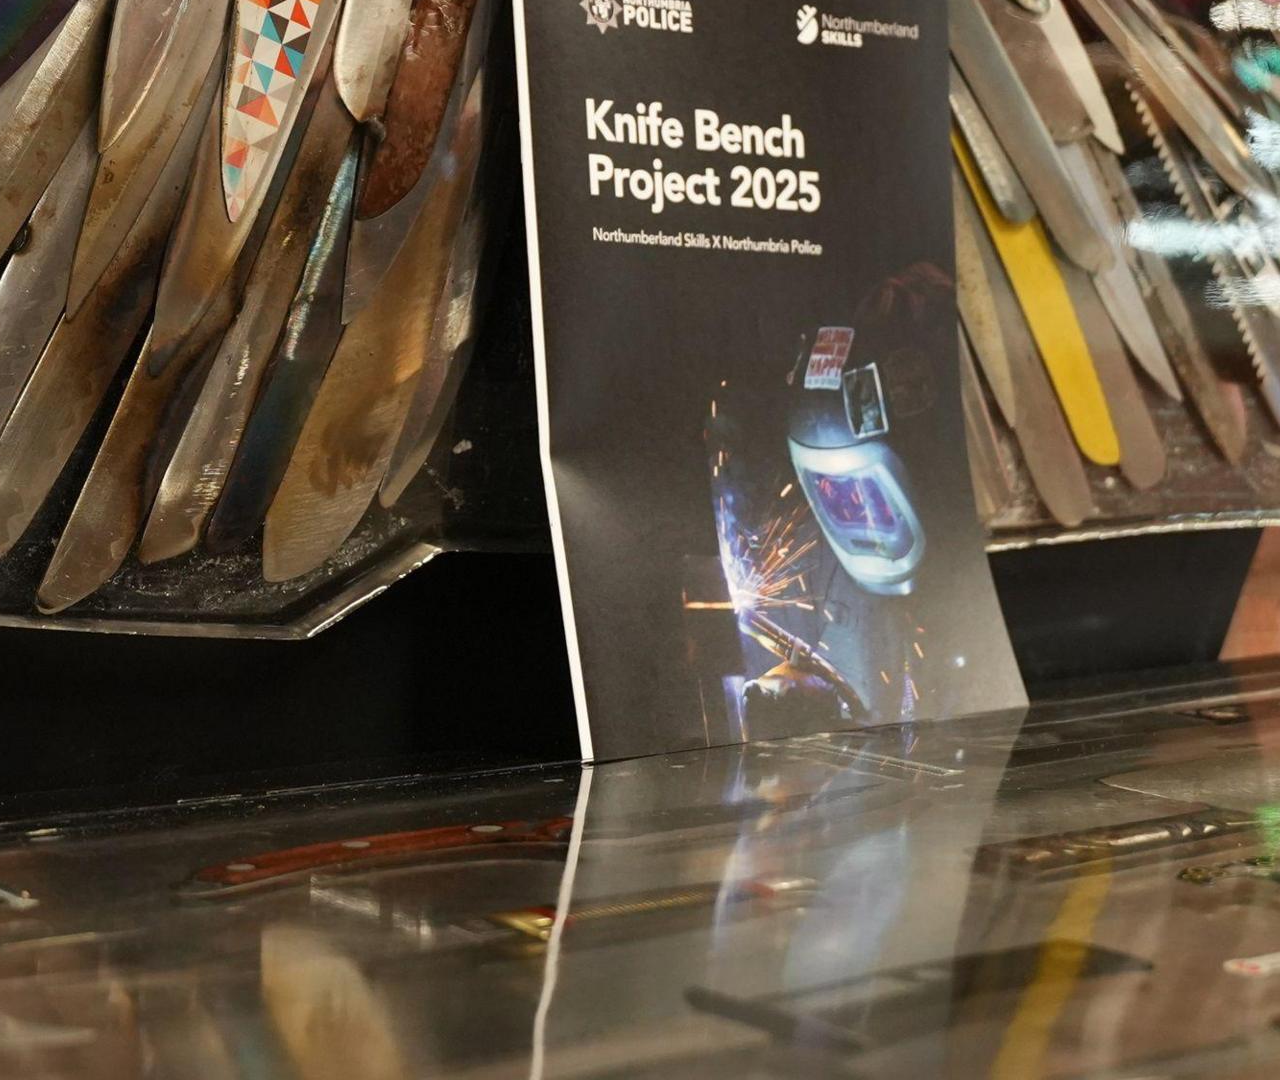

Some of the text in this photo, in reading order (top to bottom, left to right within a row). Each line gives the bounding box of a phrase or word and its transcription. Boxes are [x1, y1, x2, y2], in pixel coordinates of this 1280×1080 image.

[623, 5, 693, 33] POLICE
[821, 12, 919, 40] Northumberland
[821, 30, 863, 48] SKILLS
[585, 98, 805, 159] Knife Bench
[588, 153, 821, 214] Project 2025
[592, 227, 822, 256] Northumberland Skills X Northumbria Police
